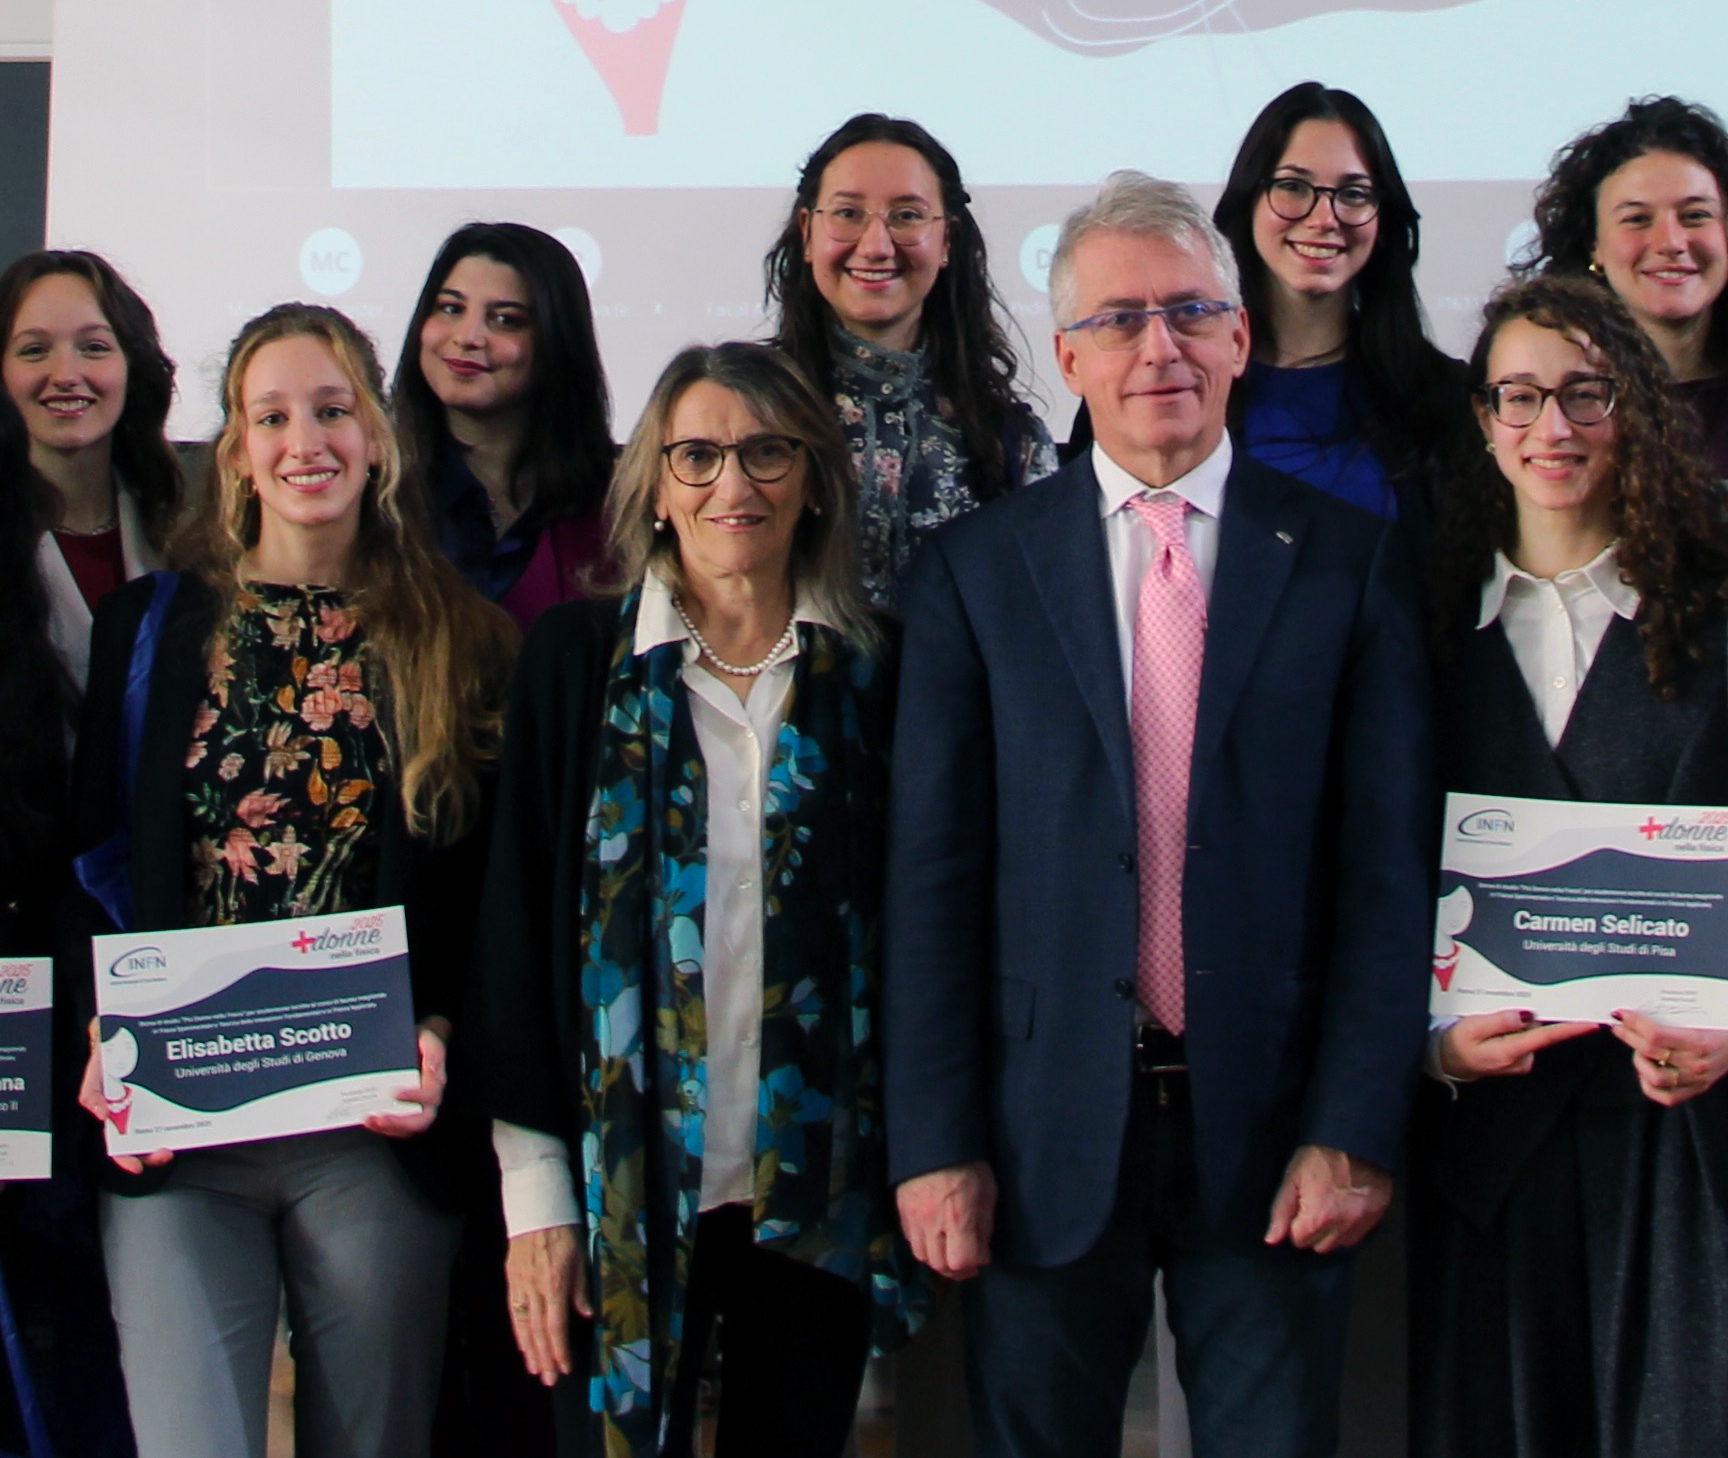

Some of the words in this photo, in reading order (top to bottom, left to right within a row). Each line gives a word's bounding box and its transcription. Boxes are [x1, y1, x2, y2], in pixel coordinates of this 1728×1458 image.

[309, 251, 350, 273] MC
[1476, 819, 1514, 832] INFN
[1514, 910, 1596, 933] Carmen
[1600, 915, 1689, 937] Selicato
[1523, 939, 1577, 953] Università
[1580, 941, 1606, 955] degli
[1608, 943, 1637, 955] Studi
[1639, 944, 1649, 955] di
[1652, 944, 1676, 957] Pisa
[129, 955, 167, 971] INFN
[166, 1032, 275, 1061] Elisabetta
[280, 1021, 352, 1047] Scotto
[175, 1062, 231, 1079] Università
[233, 1059, 260, 1074] degli
[262, 1054, 291, 1068] Studi
[294, 1053, 303, 1064] di
[306, 1048, 347, 1063] Genova
[11, 1100, 18, 1111] II
